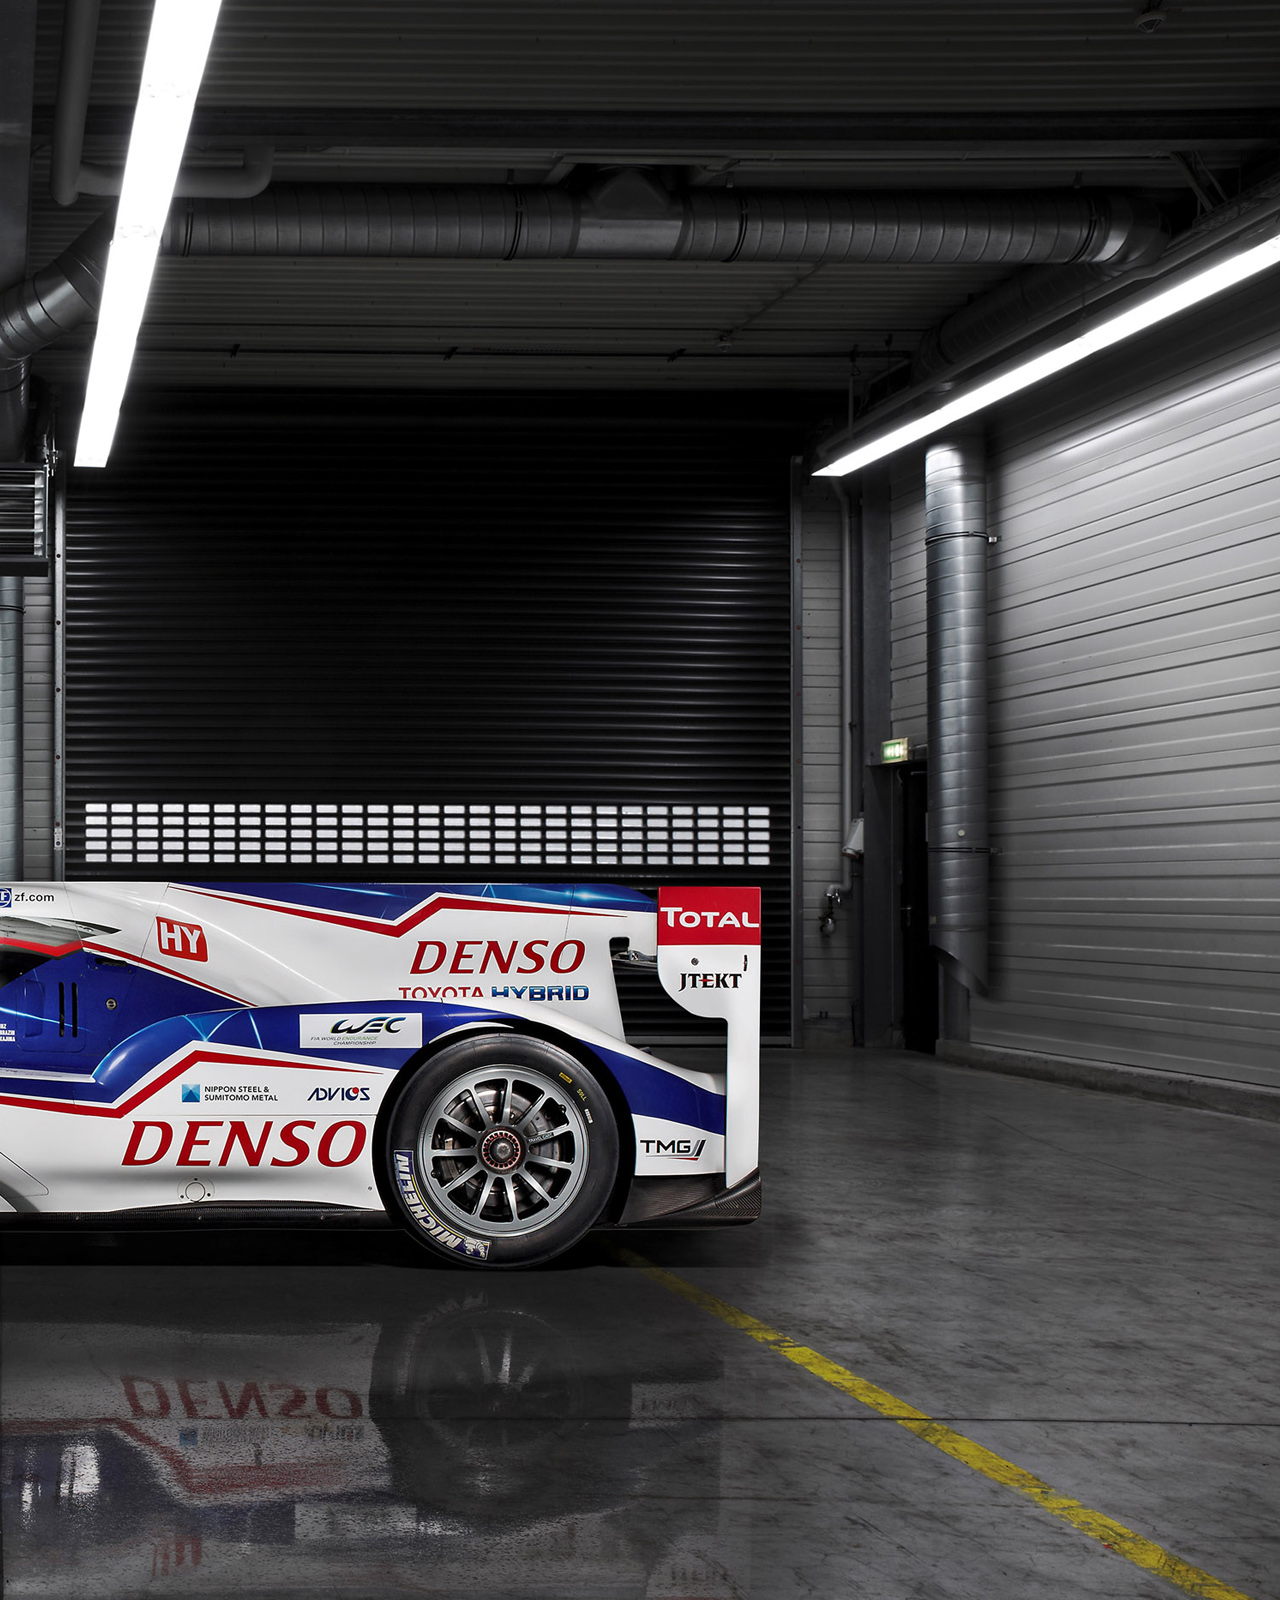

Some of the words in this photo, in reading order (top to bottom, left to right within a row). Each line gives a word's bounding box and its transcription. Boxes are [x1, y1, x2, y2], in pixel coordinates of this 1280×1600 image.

[14, 892, 55, 902] zf.com
[660, 906, 760, 928] TOTAL
[160, 921, 201, 954] HY
[410, 939, 586, 974] DENSO
[678, 972, 743, 992] JTEKT
[398, 986, 484, 999] TOYOTA
[491, 986, 589, 1001] HYBRID
[330, 1016, 407, 1034] WEC
[204, 1085, 237, 1093] NIPPON
[238, 1085, 262, 1093] STEEL
[263, 1085, 270, 1093] &
[121, 1120, 367, 1168] DENSO
[640, 1139, 691, 1154] TMG
[396, 1153, 463, 1249] MICHELIN
